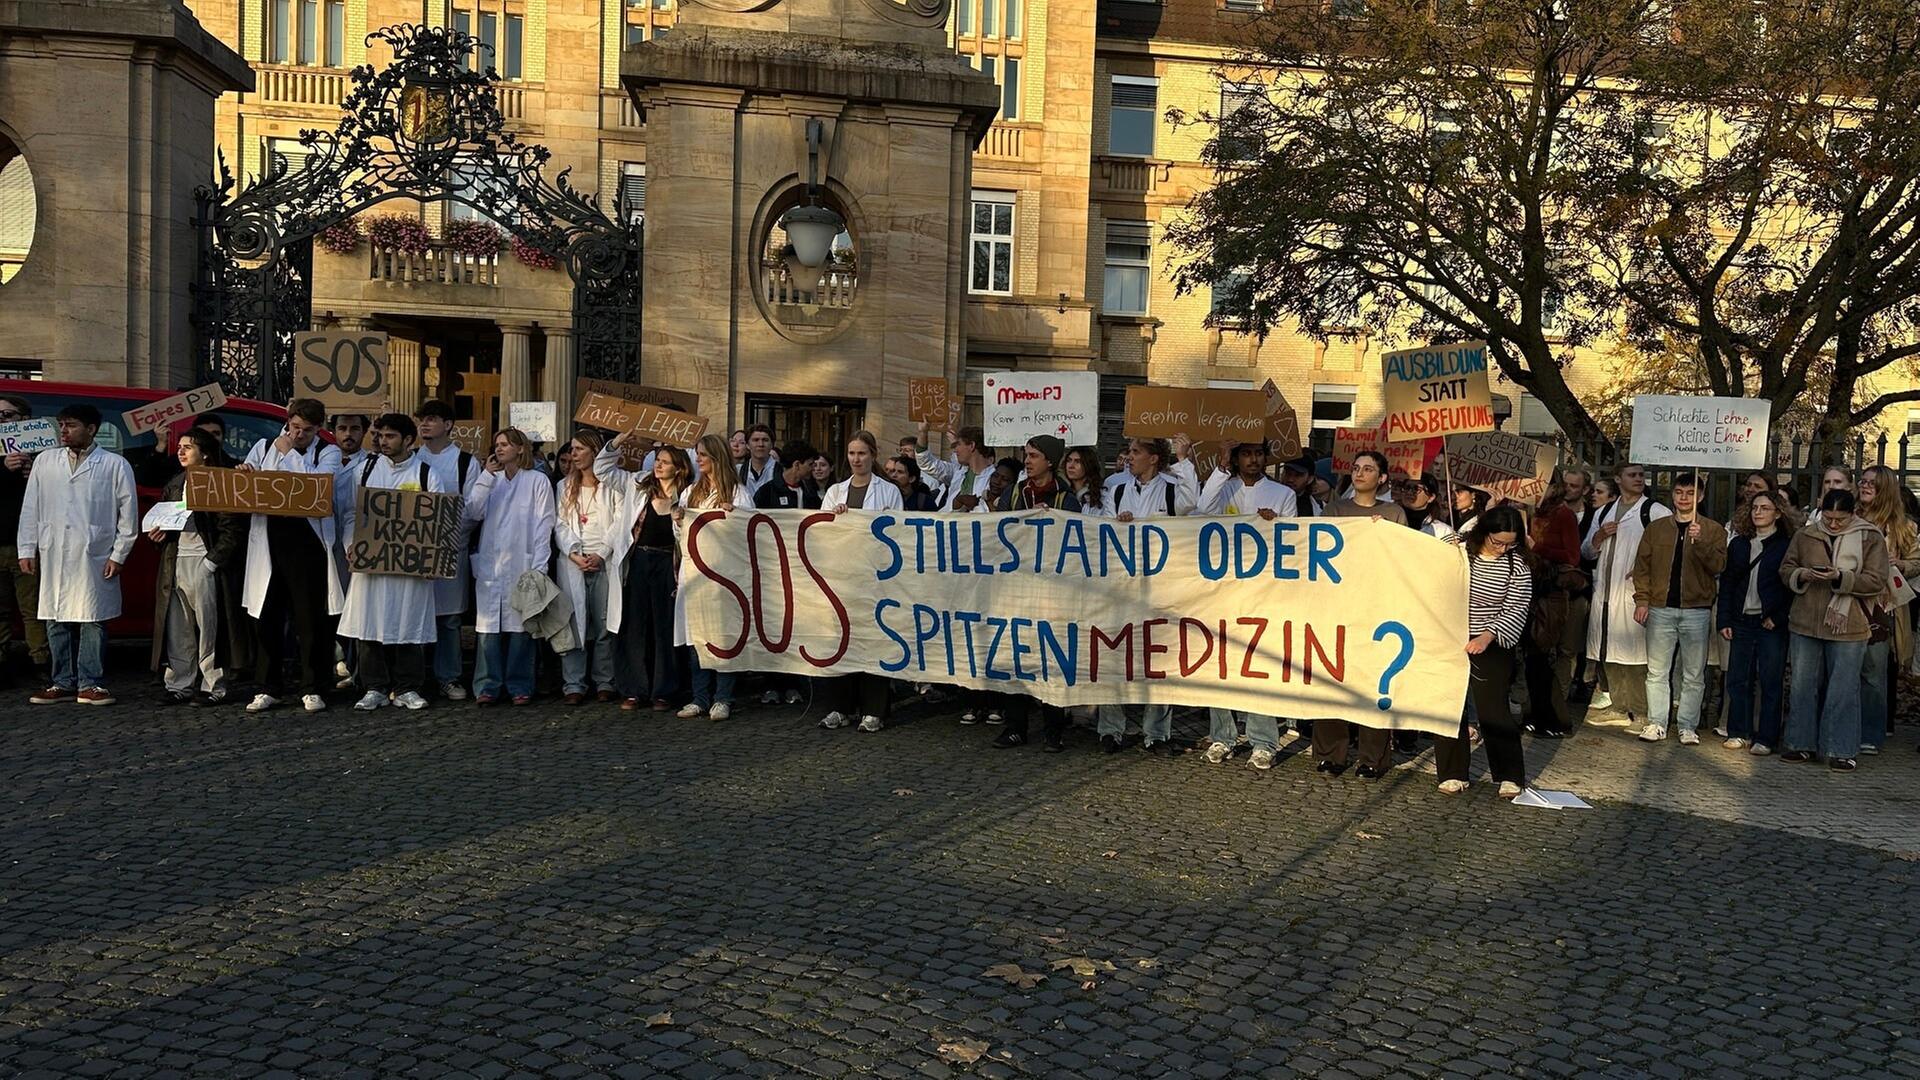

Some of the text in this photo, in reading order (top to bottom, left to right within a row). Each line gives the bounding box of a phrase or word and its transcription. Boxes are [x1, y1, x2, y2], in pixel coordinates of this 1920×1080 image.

[302, 337, 382, 395] SOS
[1385, 347, 1487, 383] AUSBILDUNG
[1043, 386, 1061, 400] PJ
[1418, 379, 1467, 402] STATT
[130, 390, 214, 430] Faires PJ
[581, 393, 703, 442] Faire LEHRE!
[1389, 405, 1494, 434] AUSBEUTUNG
[1653, 407, 1749, 425] Schlechte Lehre
[449, 424, 486, 440] BOCK
[1337, 427, 1377, 441] Damit
[1678, 427, 1752, 444] keine Ehre!
[1383, 445, 1419, 458] mehr
[1468, 444, 1538, 474] ASYSTOLIE
[363, 489, 460, 523] ICH BIN
[374, 519, 457, 550] KRANK
[871, 515, 1344, 585] STILLSTAND ODER
[688, 511, 850, 668] SOS
